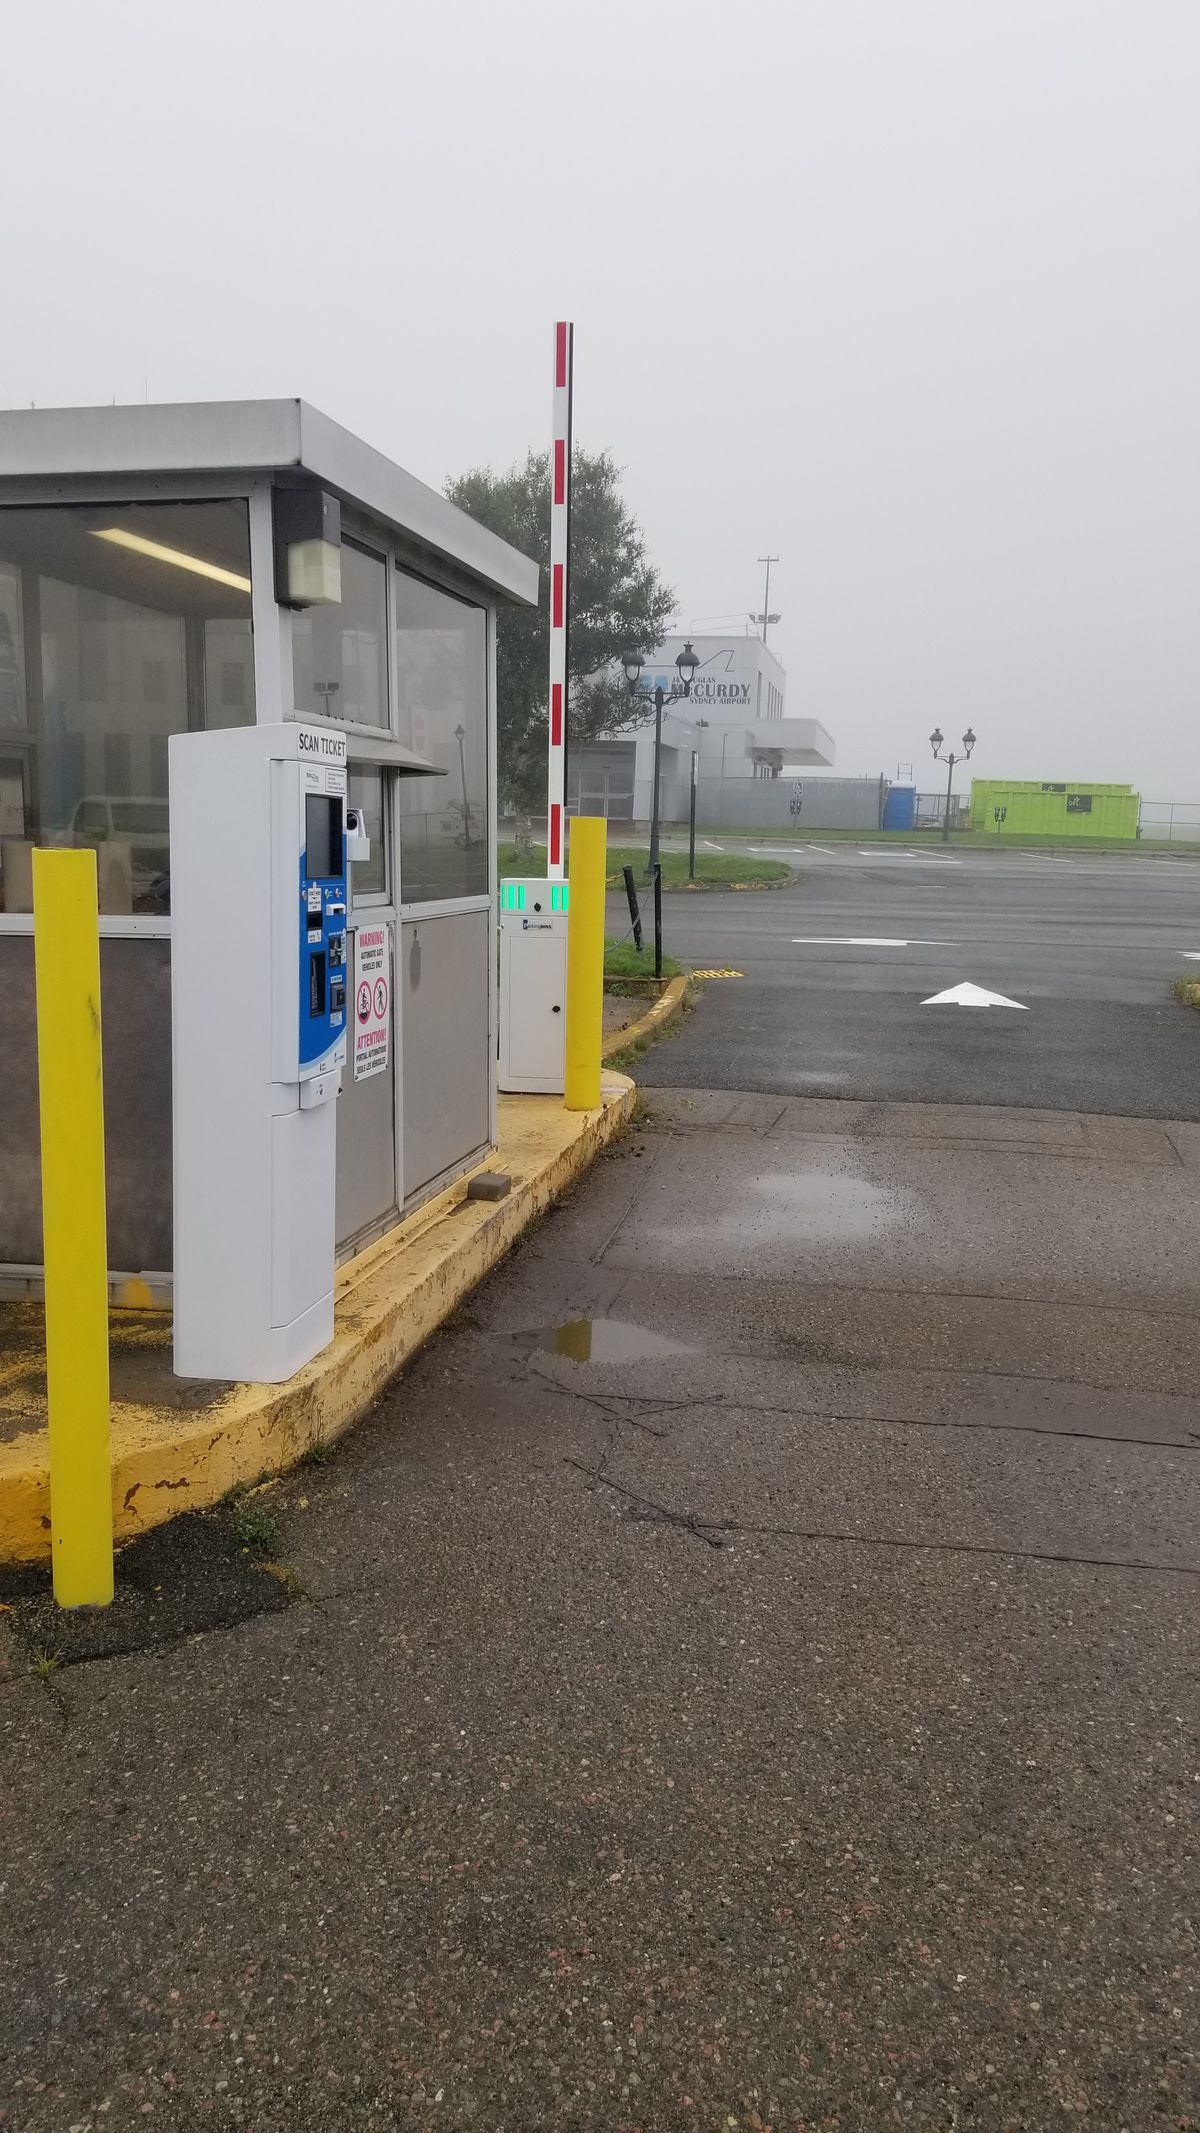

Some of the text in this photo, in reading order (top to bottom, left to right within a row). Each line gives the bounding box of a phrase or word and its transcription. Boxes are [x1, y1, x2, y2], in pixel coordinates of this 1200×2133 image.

[299, 732, 346, 757] SCAN TICKET
[359, 930, 384, 947] WARNING!
[357, 1028, 387, 1050] ATTENTION!
